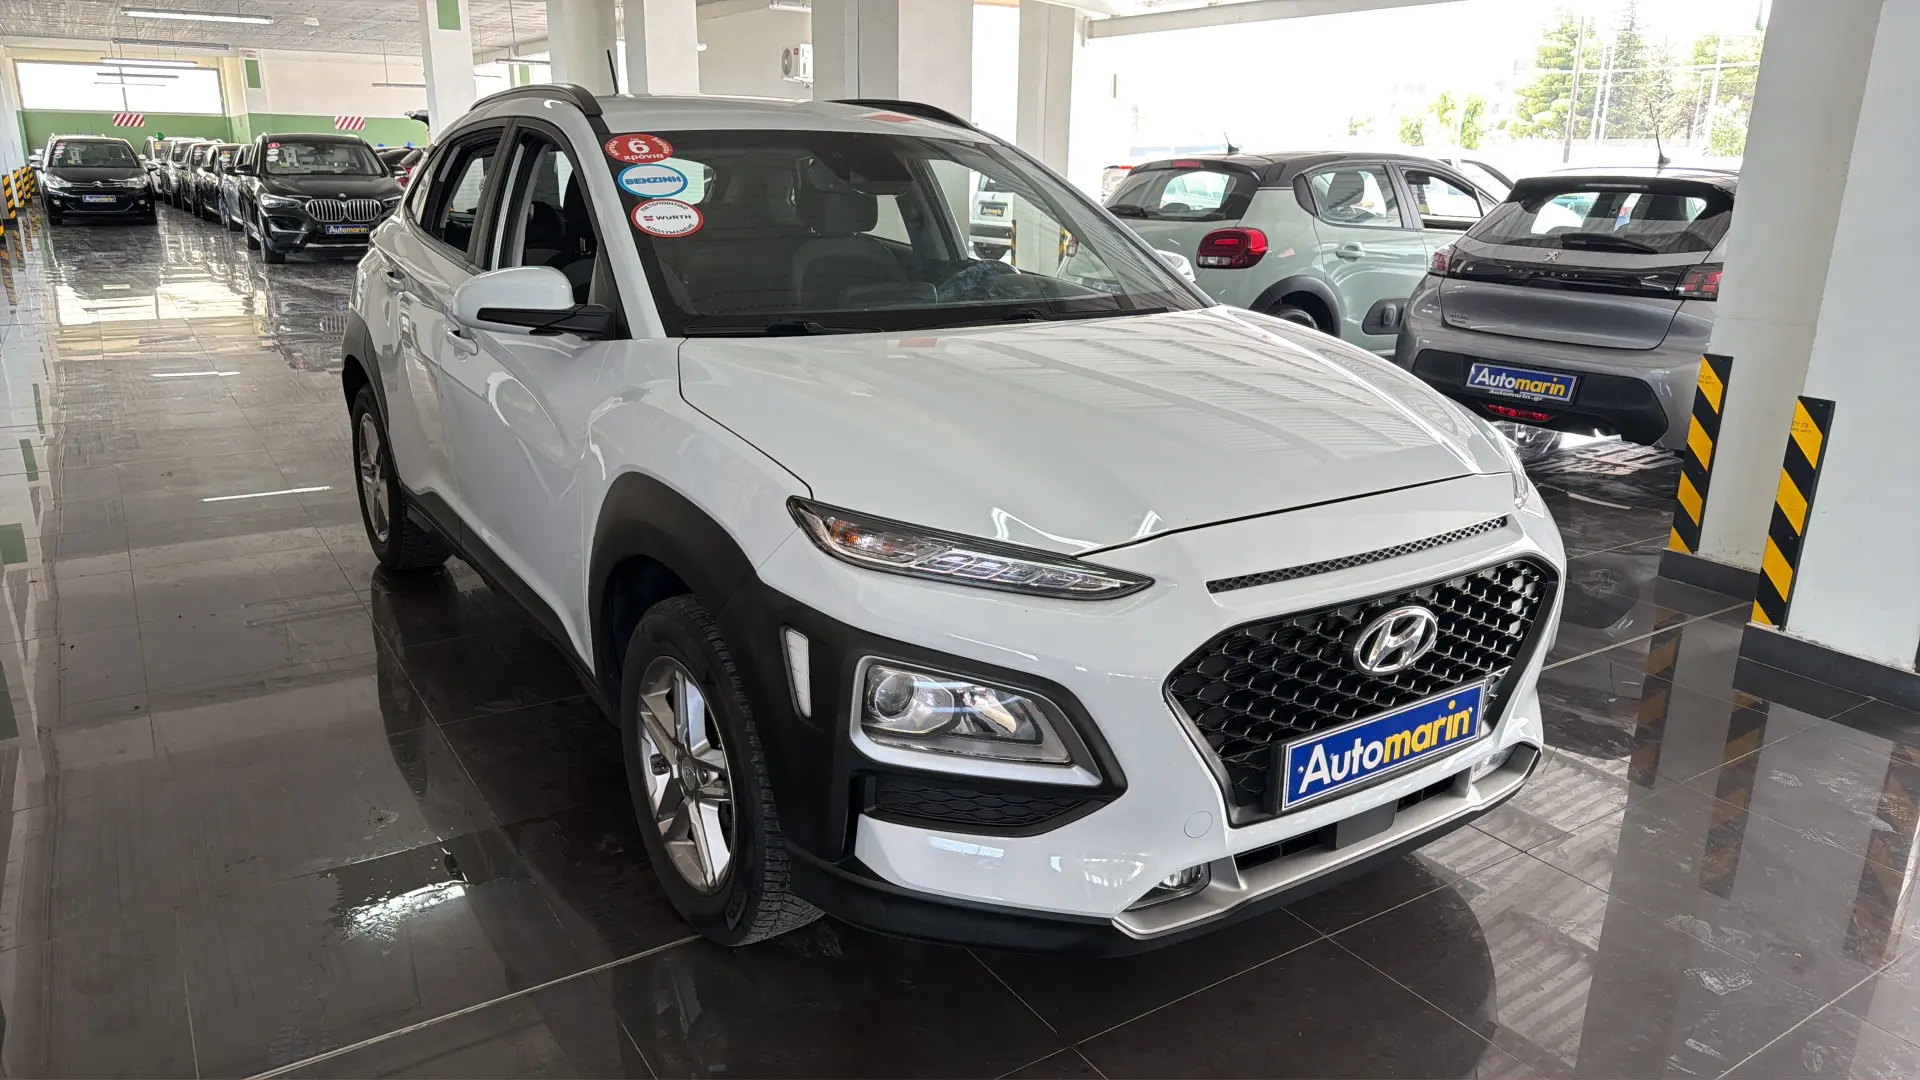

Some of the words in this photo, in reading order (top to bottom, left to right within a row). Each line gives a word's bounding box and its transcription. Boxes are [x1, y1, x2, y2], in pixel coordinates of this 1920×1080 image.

[628, 140, 650, 154] 6
[624, 153, 664, 161] χρόνια
[329, 224, 367, 233] Automarin
[1508, 268, 1580, 279] PEUGEOT
[1474, 367, 1566, 397] Automarin
[1488, 389, 1544, 402] Automarin.gr
[1298, 699, 1471, 795] Automarin
